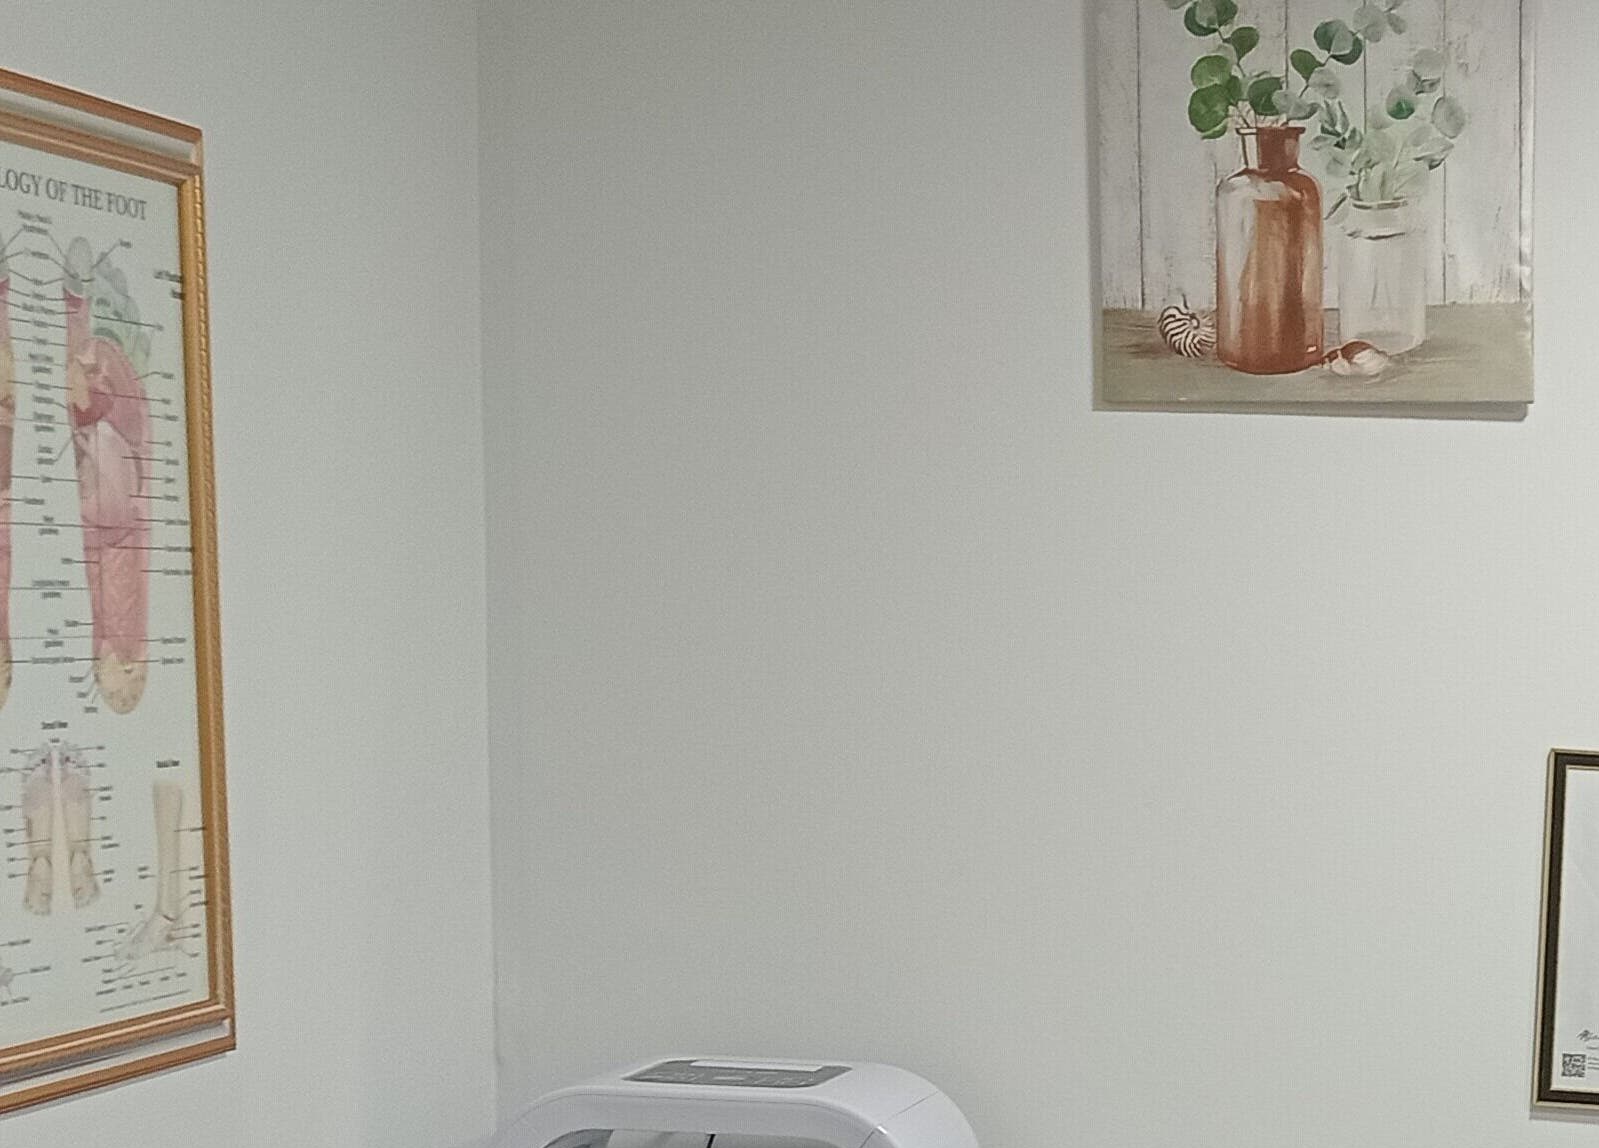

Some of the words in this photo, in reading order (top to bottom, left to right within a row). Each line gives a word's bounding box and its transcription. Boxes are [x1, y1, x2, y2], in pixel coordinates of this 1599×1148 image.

[46, 178, 67, 202] OF
[71, 183, 103, 210] THE
[106, 191, 147, 220] FOOT
